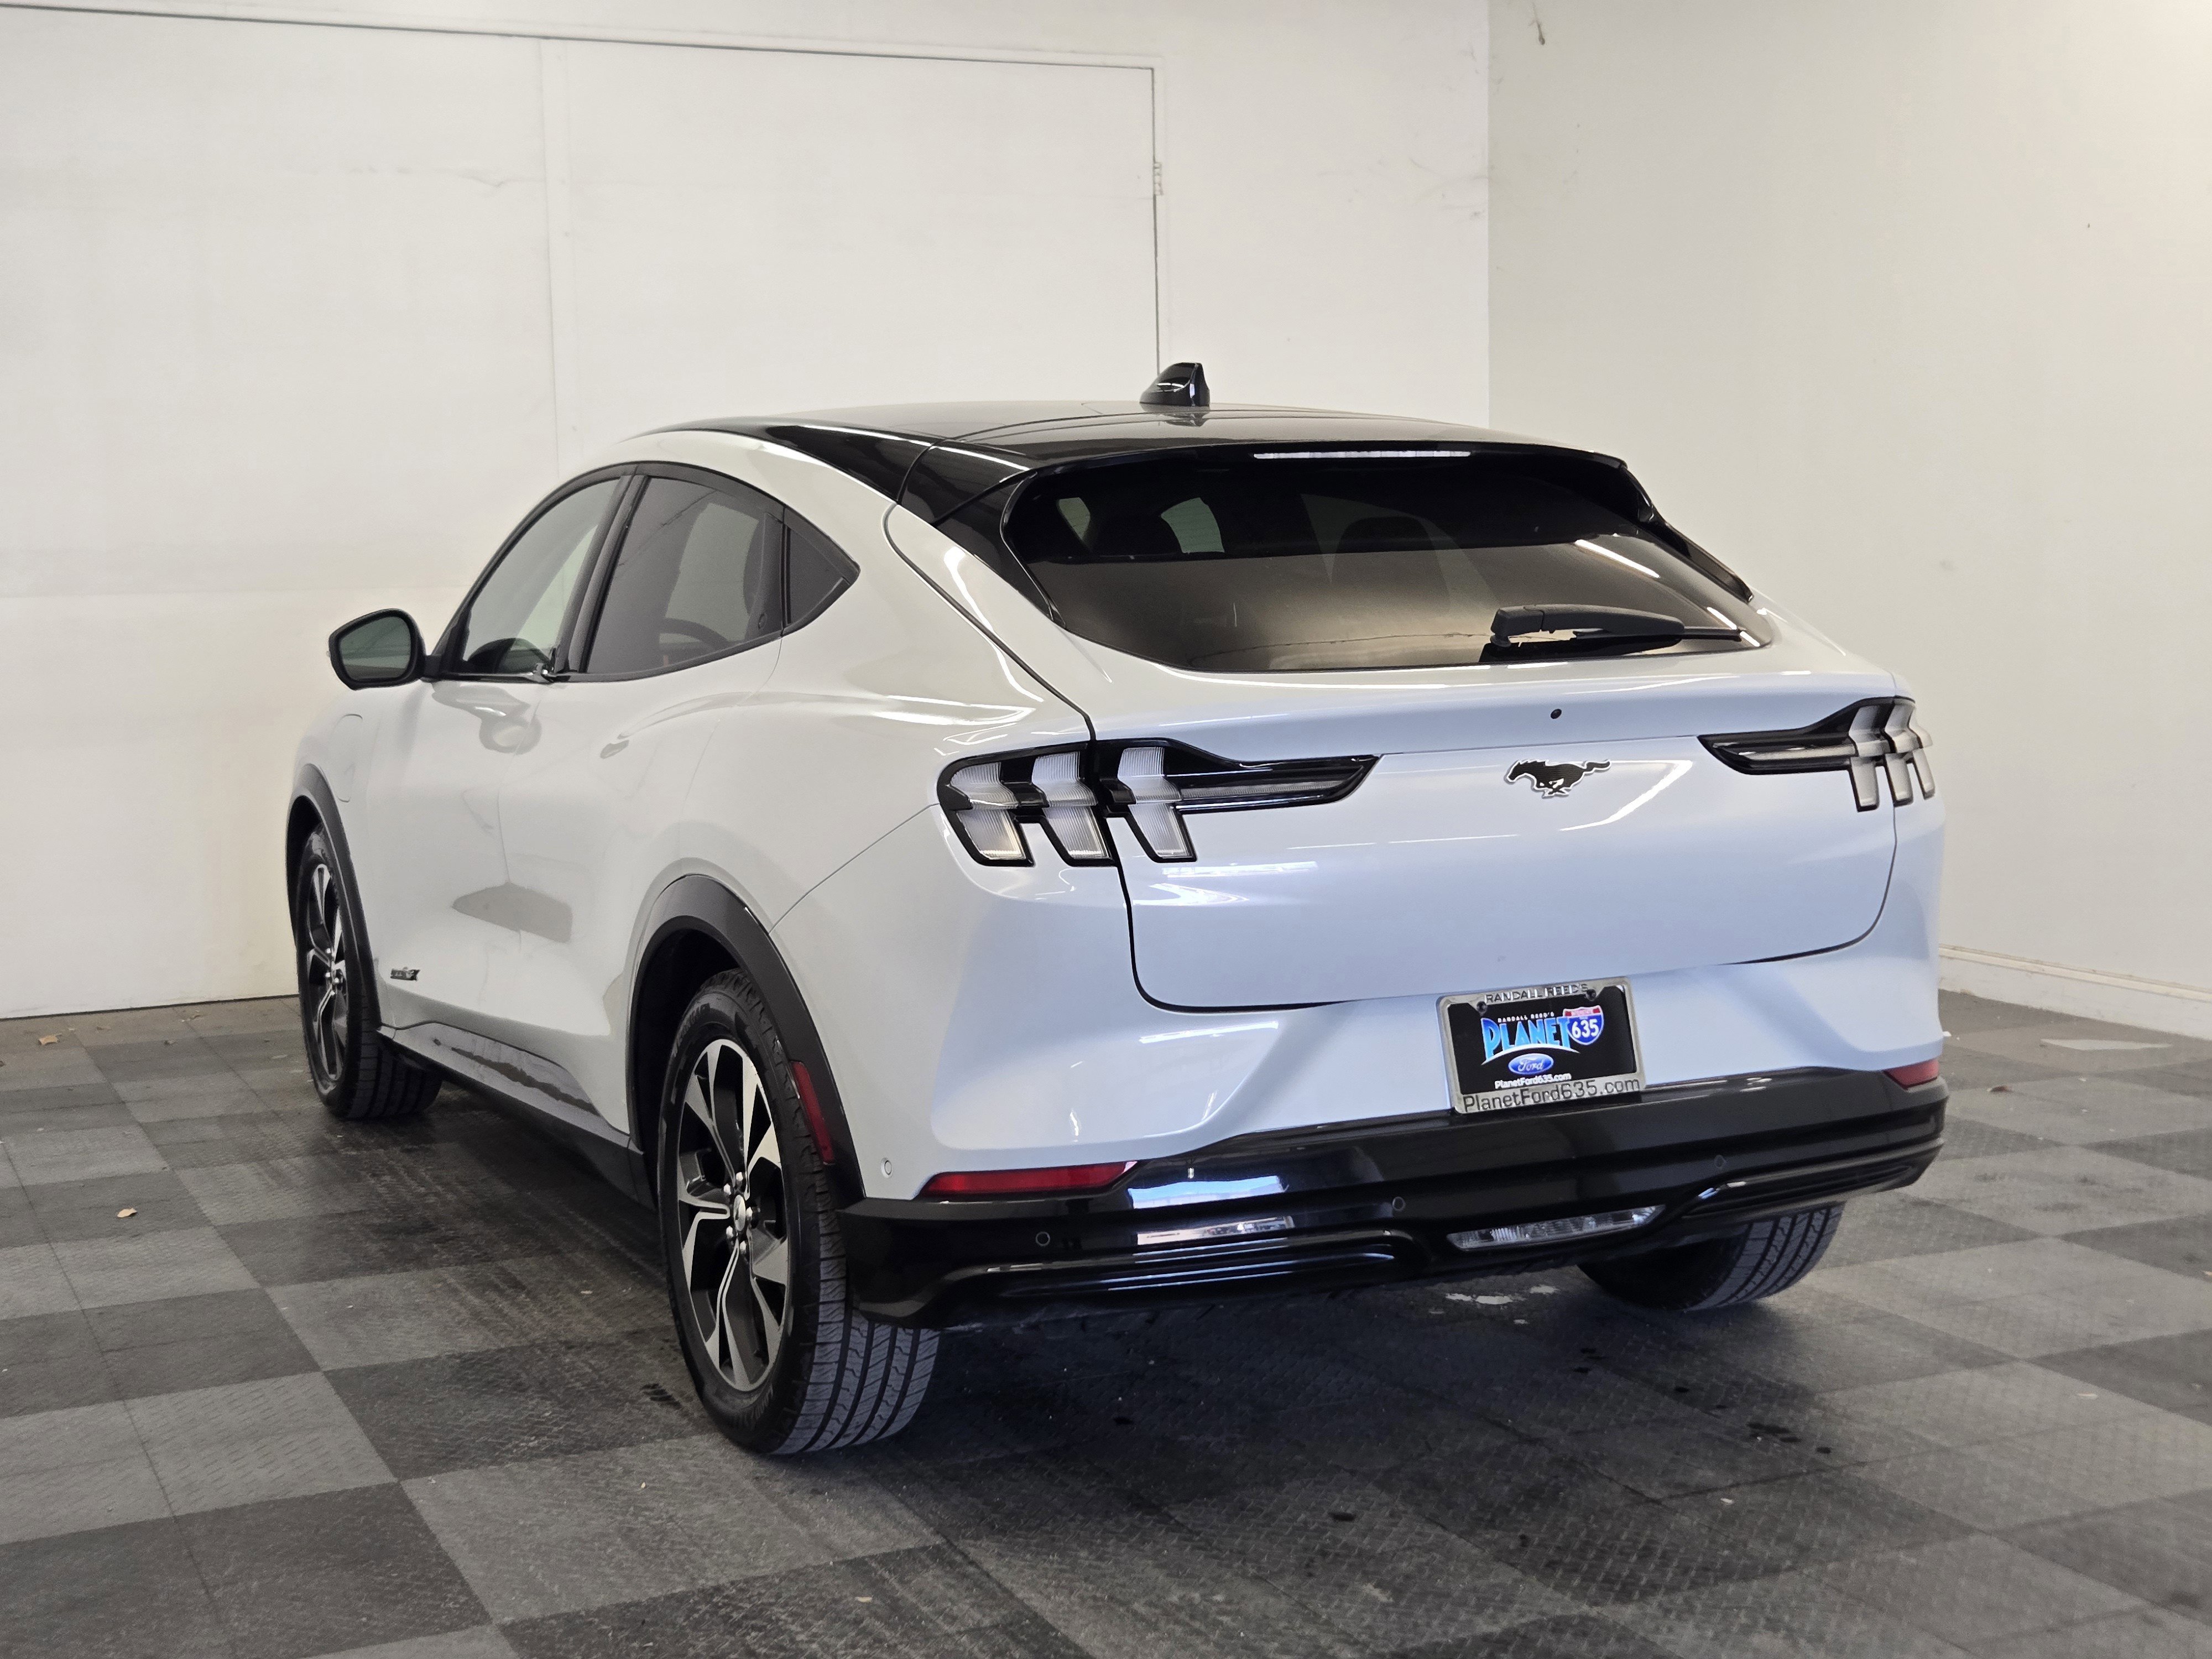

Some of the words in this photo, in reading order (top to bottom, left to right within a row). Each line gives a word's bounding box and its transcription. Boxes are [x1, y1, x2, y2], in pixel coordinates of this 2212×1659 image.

[1484, 989, 1543, 1004] RANDALL
[1545, 983, 1589, 997] REED'S
[1480, 1016, 1571, 1060] PLANET
[1571, 1018, 1599, 1039] 635
[1517, 1058, 1543, 1072] Ford
[1495, 1073, 1572, 1089] PlanetFord635.com
[1462, 1078, 1640, 1113] PlanetFord635.com
